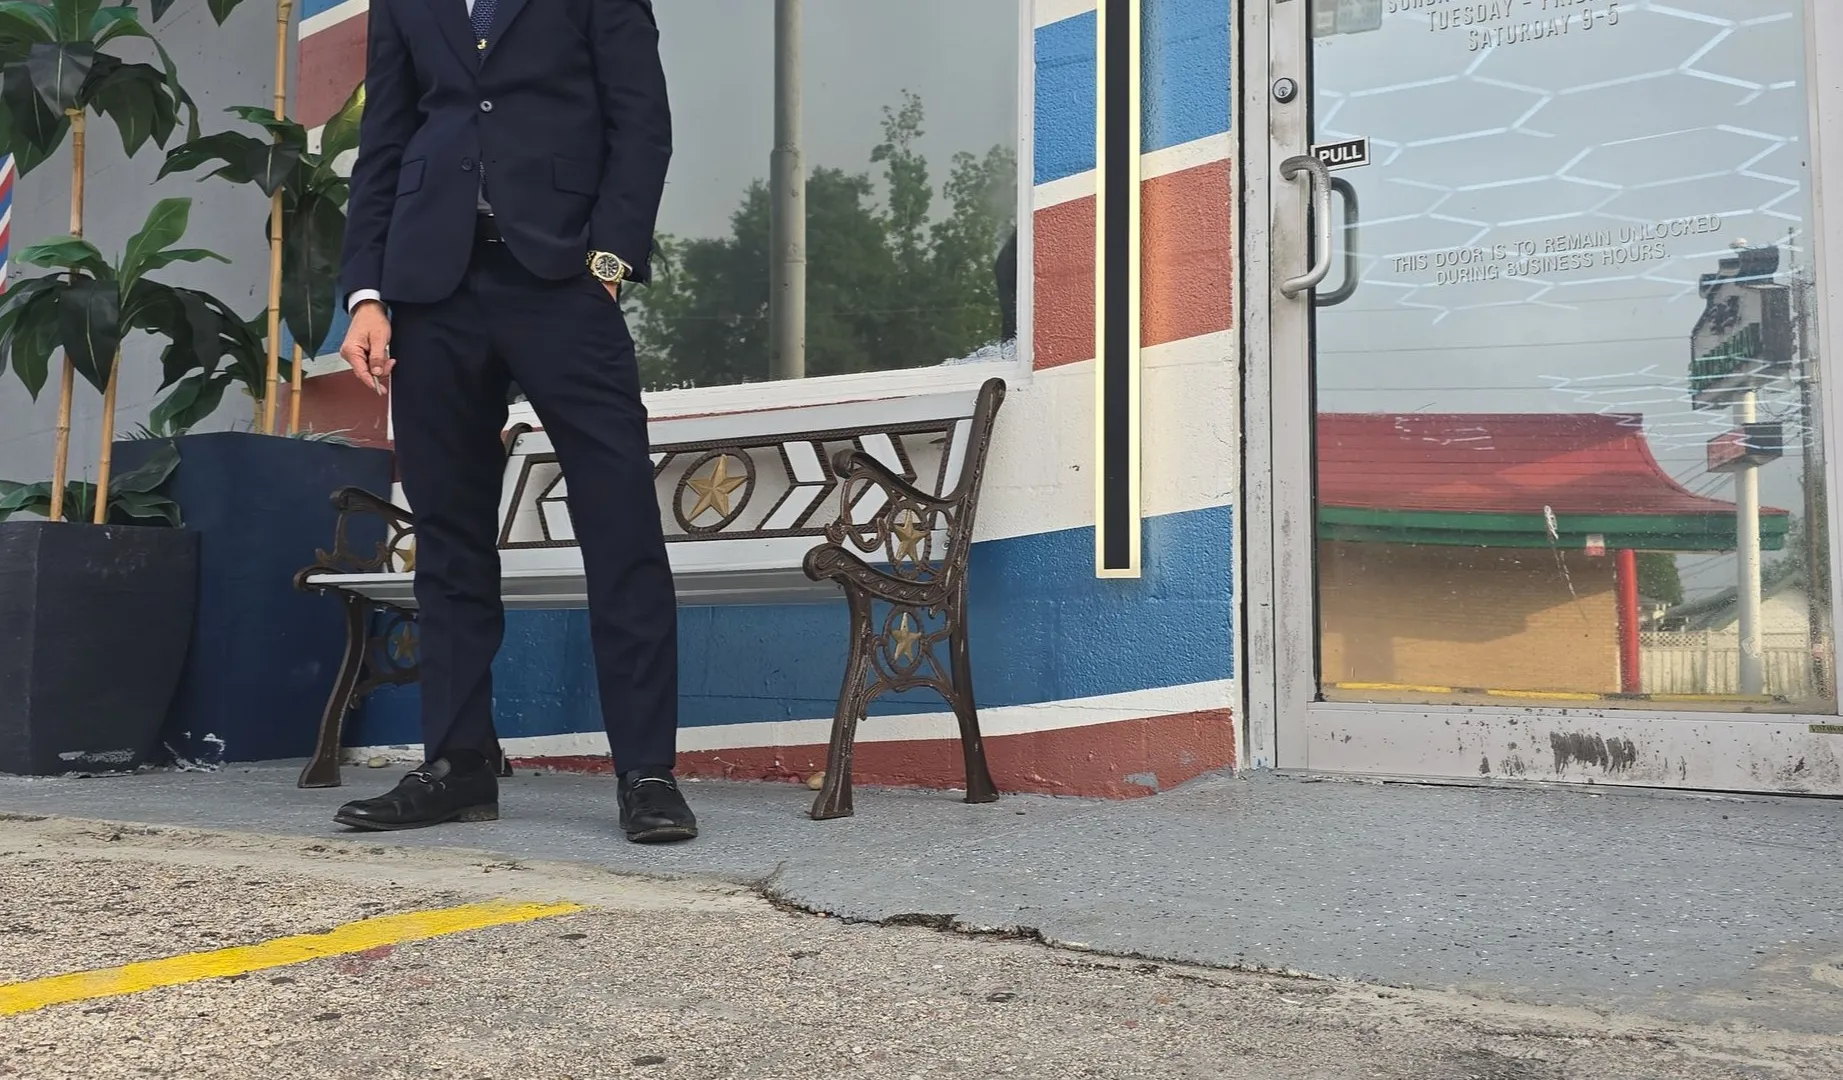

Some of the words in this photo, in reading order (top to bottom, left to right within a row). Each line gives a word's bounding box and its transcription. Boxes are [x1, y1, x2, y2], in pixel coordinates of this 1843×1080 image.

[1427, 0, 1512, 32] TUESDAY
[1468, 14, 1571, 51] SATURDAY
[1582, 3, 1619, 31] 9-5
[1319, 145, 1362, 162] PULL
[1392, 254, 1428, 273] THIS
[1435, 246, 1484, 267] DOOR
[1490, 244, 1507, 261] IS
[1513, 239, 1537, 258] TO
[1544, 230, 1611, 253] REMAIN
[1619, 214, 1722, 244] UNLOCKED
[1436, 263, 1499, 286] DURING
[1507, 253, 1593, 277] BUSINESS
[1602, 243, 1671, 264] HOURS.
